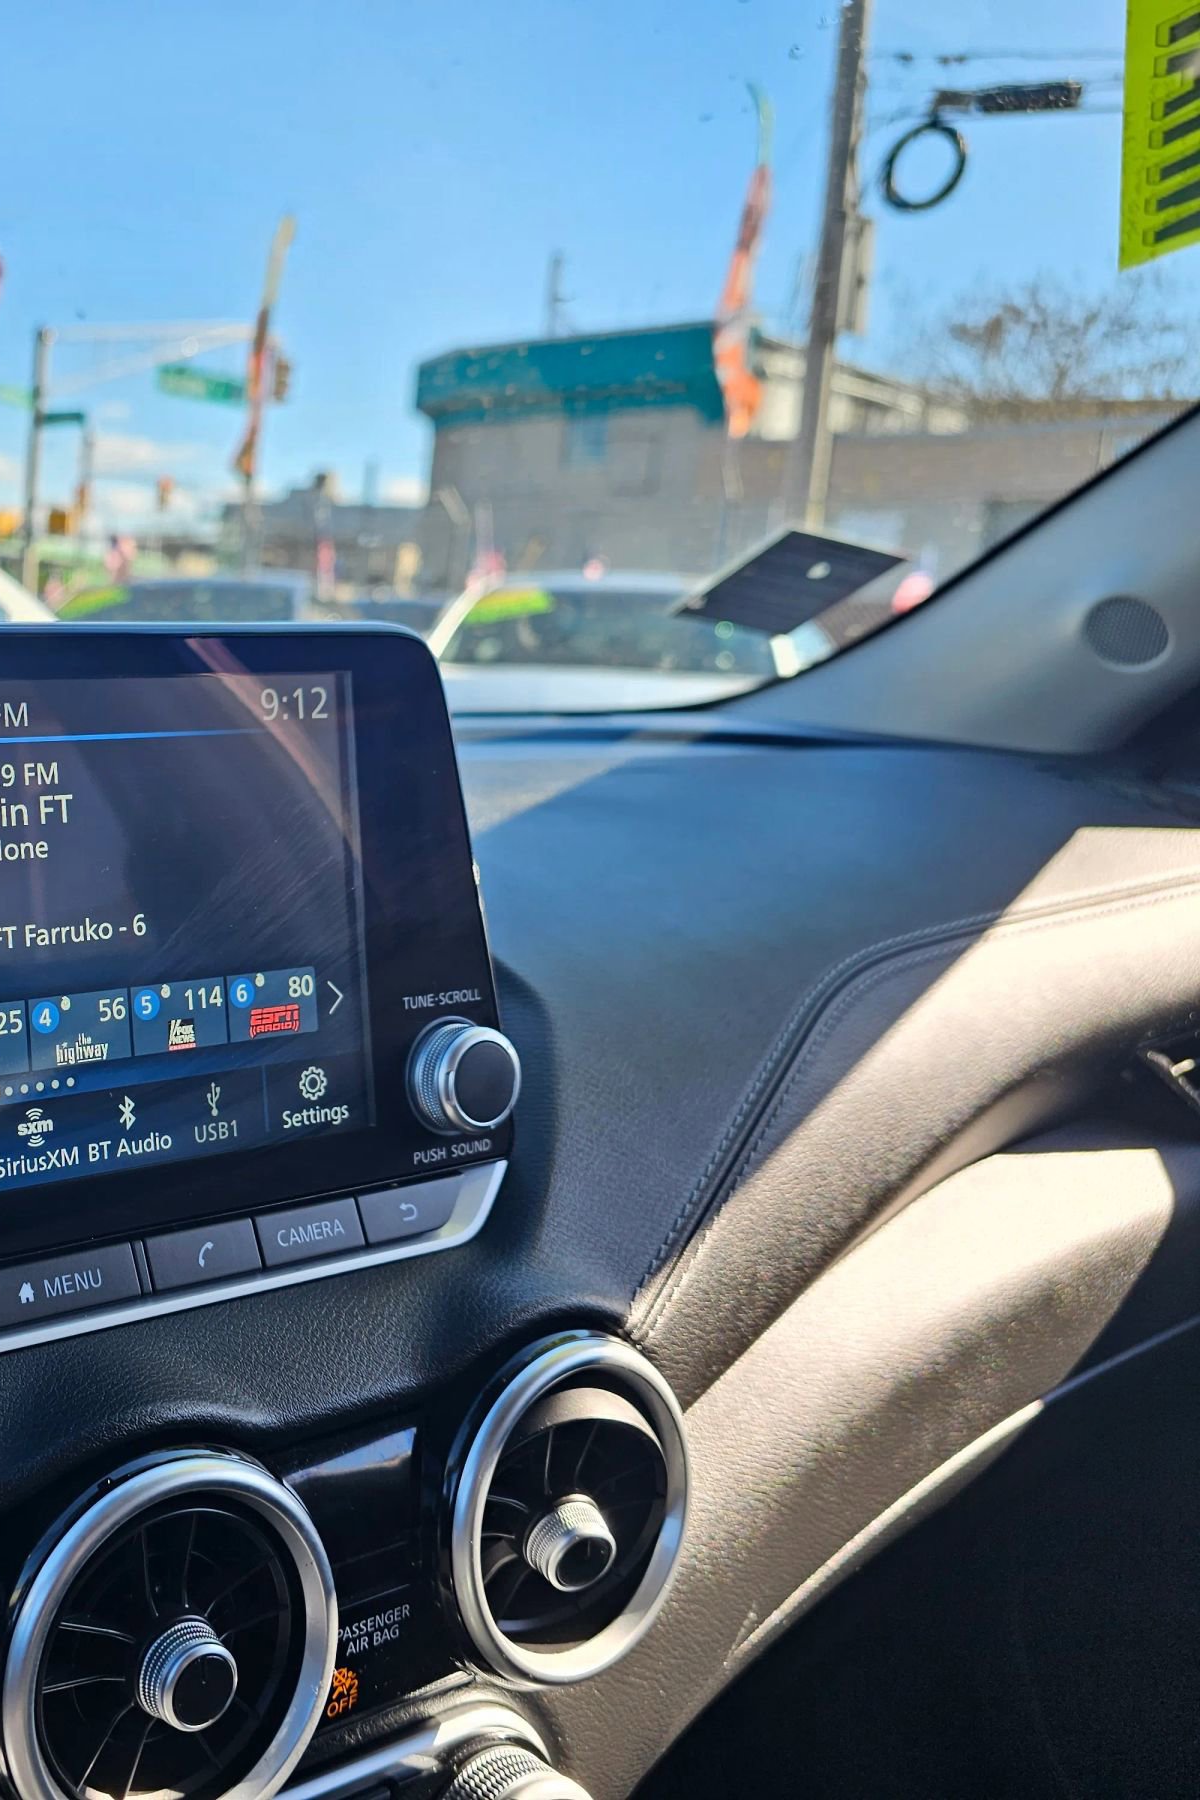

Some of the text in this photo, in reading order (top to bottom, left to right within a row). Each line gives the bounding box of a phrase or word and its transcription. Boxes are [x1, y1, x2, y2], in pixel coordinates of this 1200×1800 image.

[260, 686, 328, 722] 9:12
[23, 762, 59, 786] FM
[39, 794, 73, 824] FT
[24, 917, 113, 948] Farruko
[132, 914, 146, 937] 6
[184, 985, 223, 1012] 114
[236, 983, 248, 1003] 6
[288, 974, 314, 999] 80
[99, 997, 126, 1023] 56
[141, 995, 153, 1014] 5
[250, 1003, 300, 1026] ESPN
[38, 1008, 52, 1028] 4
[56, 1042, 109, 1064] highway
[17, 1118, 54, 1137] sxm
[282, 1103, 349, 1130] Settings
[194, 1119, 239, 1144] USB1
[88, 1132, 173, 1162] BT Audio
[413, 1138, 492, 1165] PUSH SOUND
[277, 1217, 345, 1249] CAMERA
[43, 1268, 103, 1300] MENU
[346, 1624, 400, 1657] AIR BAG
[326, 1694, 359, 1718] OFF
